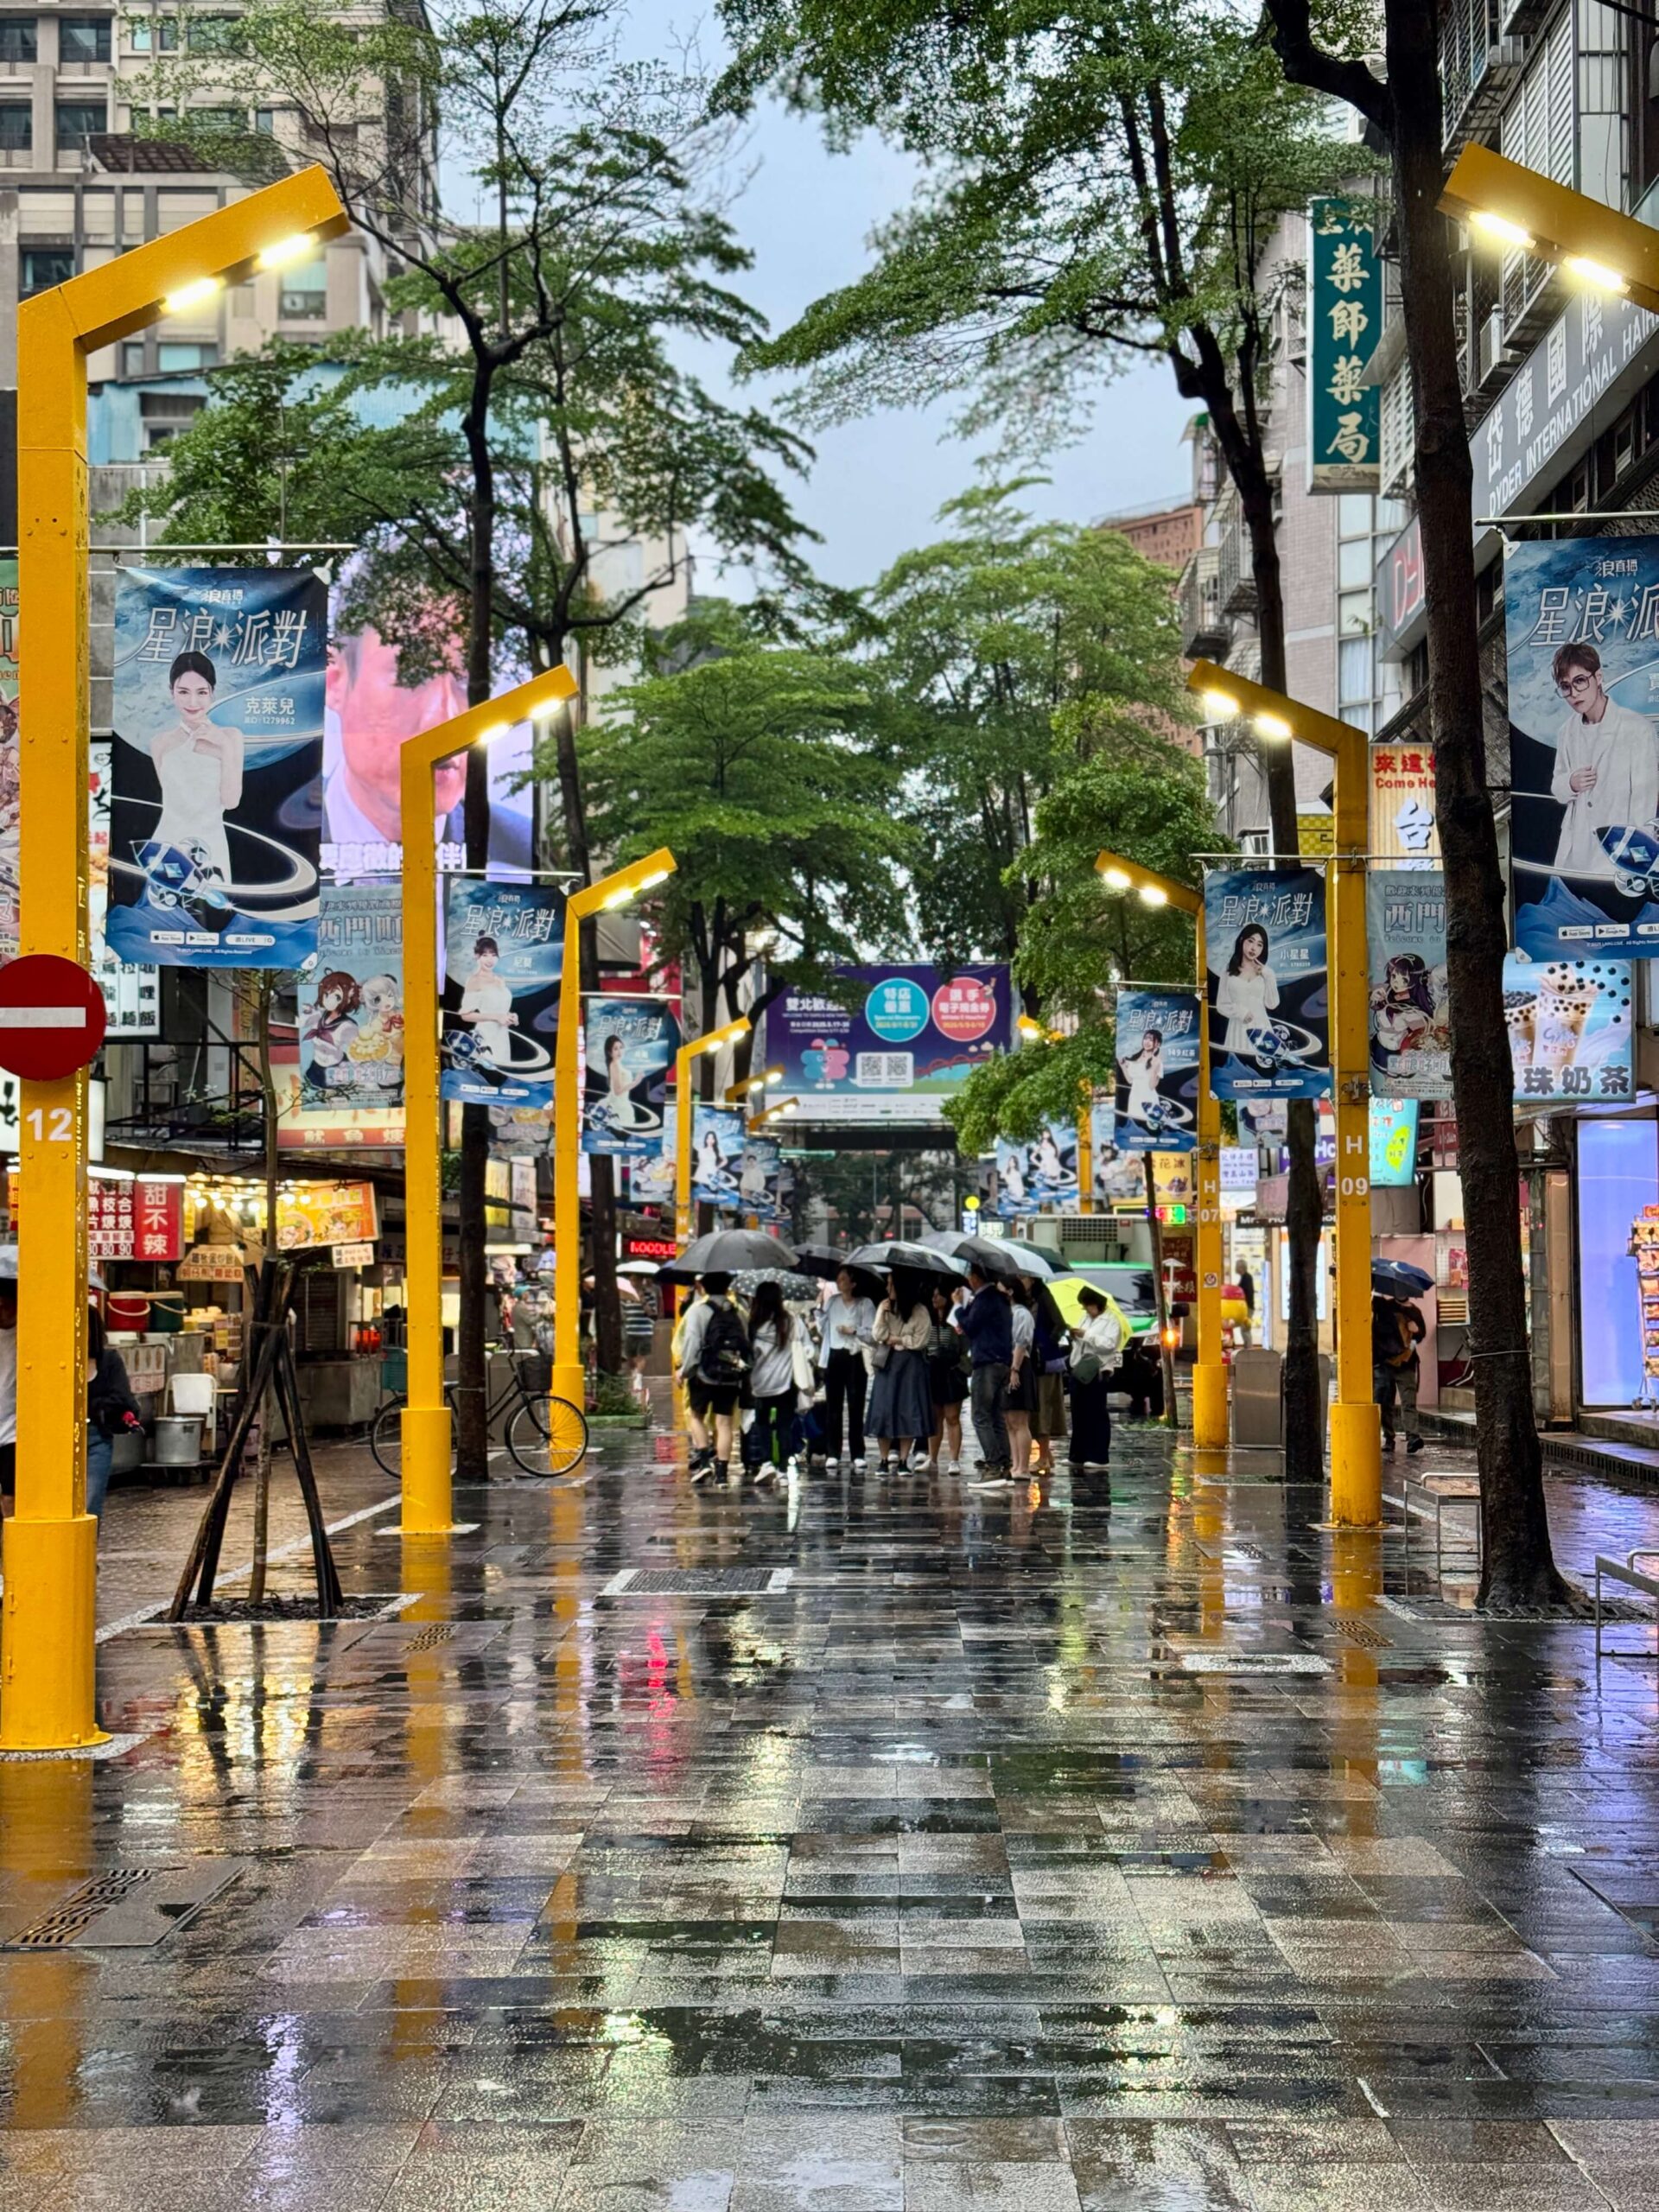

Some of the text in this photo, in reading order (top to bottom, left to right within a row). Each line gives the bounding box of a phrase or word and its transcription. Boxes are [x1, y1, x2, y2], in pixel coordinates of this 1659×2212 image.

[1489, 460, 1522, 520] DYDER
[1526, 346, 1617, 477] INTERNATIONAL
[137, 607, 307, 669] 星浪派對
[245, 696, 295, 715] 克萊兒
[1376, 778, 1415, 788] Come
[1218, 893, 1313, 927] 星浪派對
[460, 905, 555, 941] 星浪派對
[1281, 949, 1309, 960] 小星星
[1127, 1009, 1193, 1033] 星浪派對
[1523, 1066, 1630, 1095] 珠奶茶
[27, 1108, 73, 1141] 12
[1345, 1135, 1363, 1154] H
[1153, 1158, 1185, 1169] 花冰
[1204, 1180, 1216, 1193] H
[1341, 1177, 1368, 1196] 09
[143, 1184, 168, 1255] 甜不辣
[1200, 1209, 1217, 1222] 07
[102, 1243, 114, 1255] 80
[118, 1243, 131, 1255] 90
